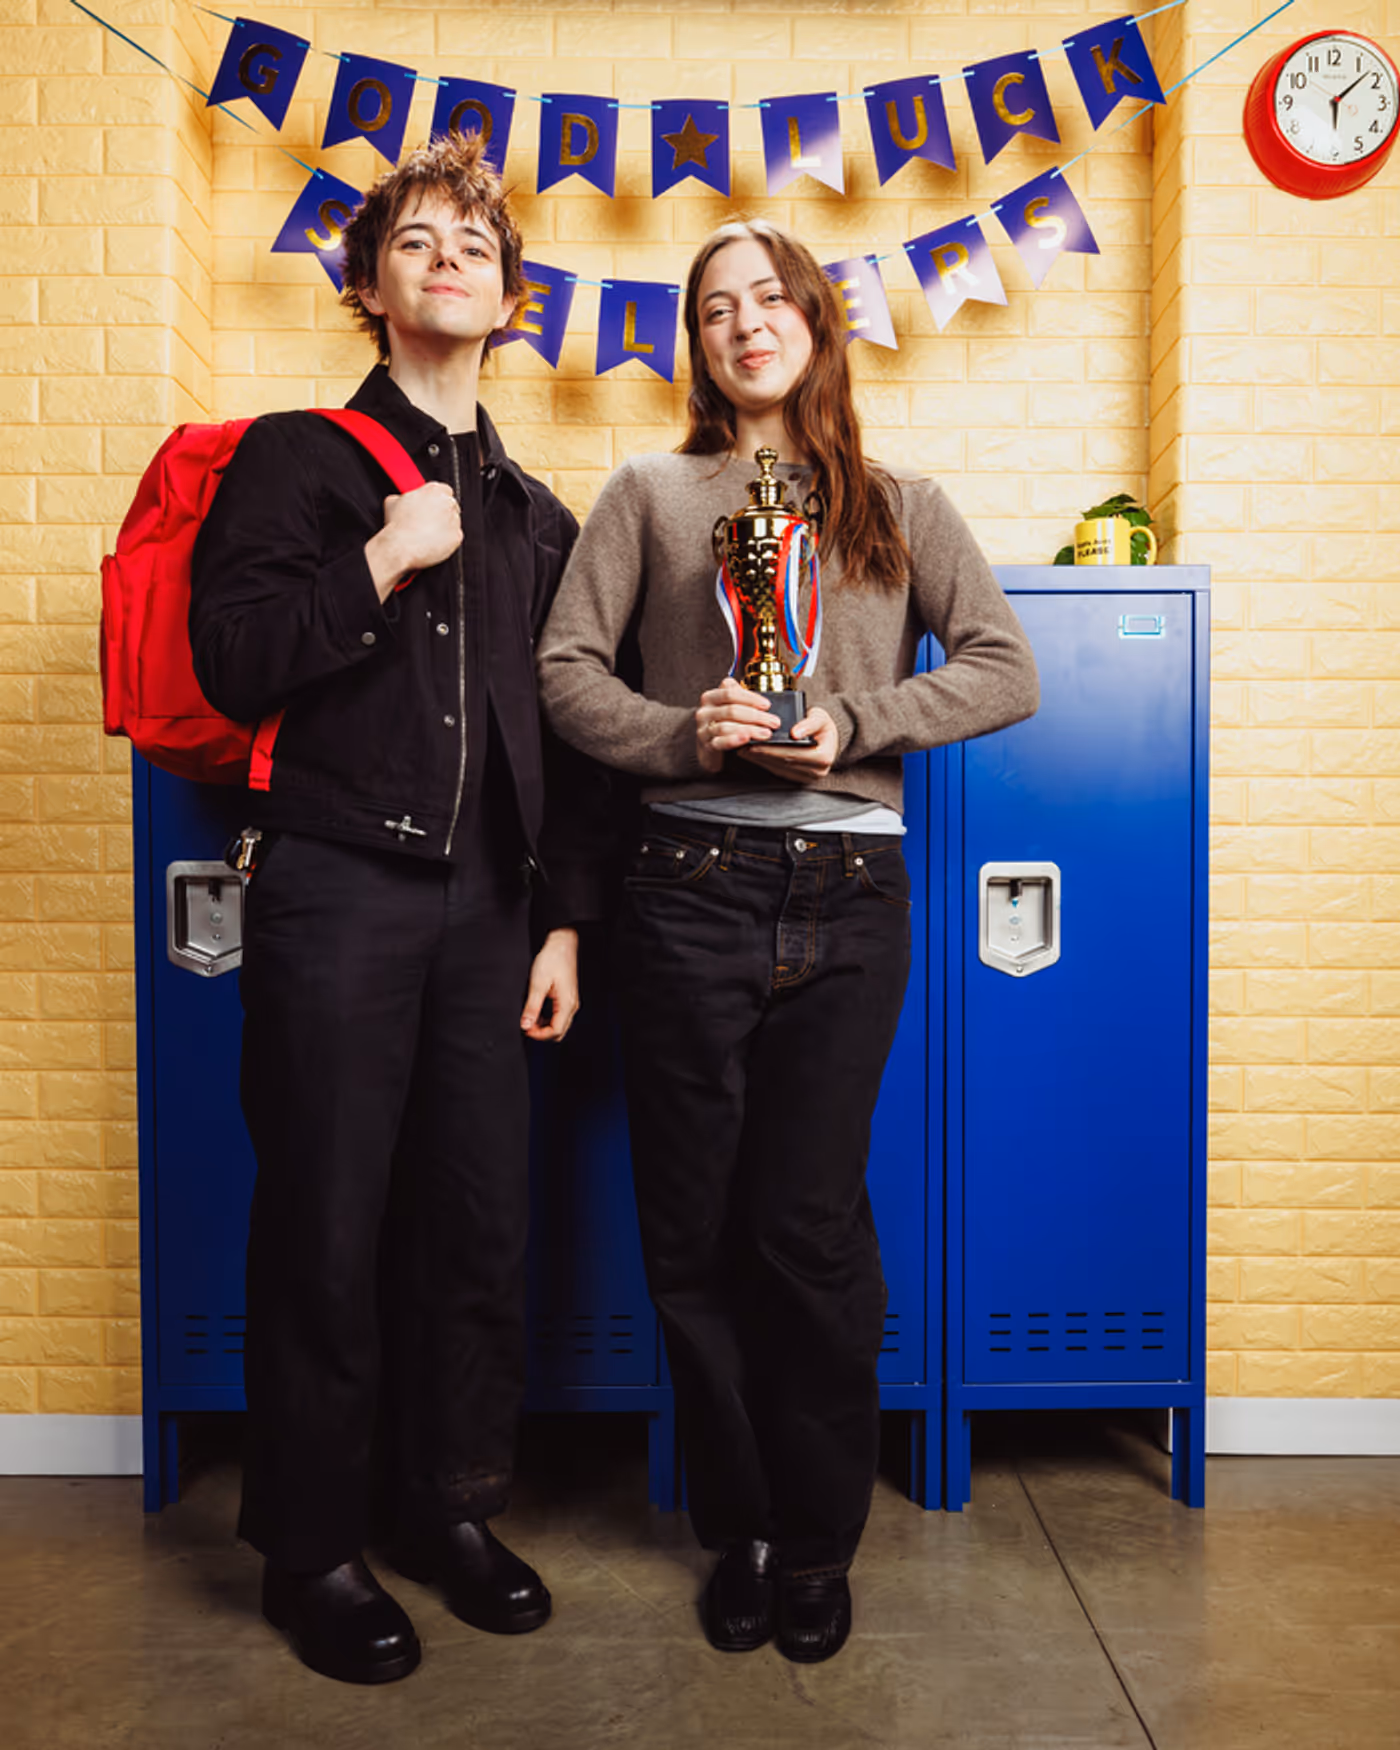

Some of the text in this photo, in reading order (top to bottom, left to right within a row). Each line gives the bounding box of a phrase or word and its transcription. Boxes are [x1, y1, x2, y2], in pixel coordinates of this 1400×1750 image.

[1308, 56, 1320, 73] 11
[1327, 49, 1342, 66] 12
[1290, 72, 1307, 89] 10
[1370, 72, 1380, 90] 2
[238, 37, 1143, 169] GOOD LUCK
[1282, 94, 1294, 111] 9
[1377, 94, 1388, 112] 3
[1368, 119, 1379, 134] 4
[1353, 135, 1364, 151] 5
[304, 196, 1068, 355] SELERS
